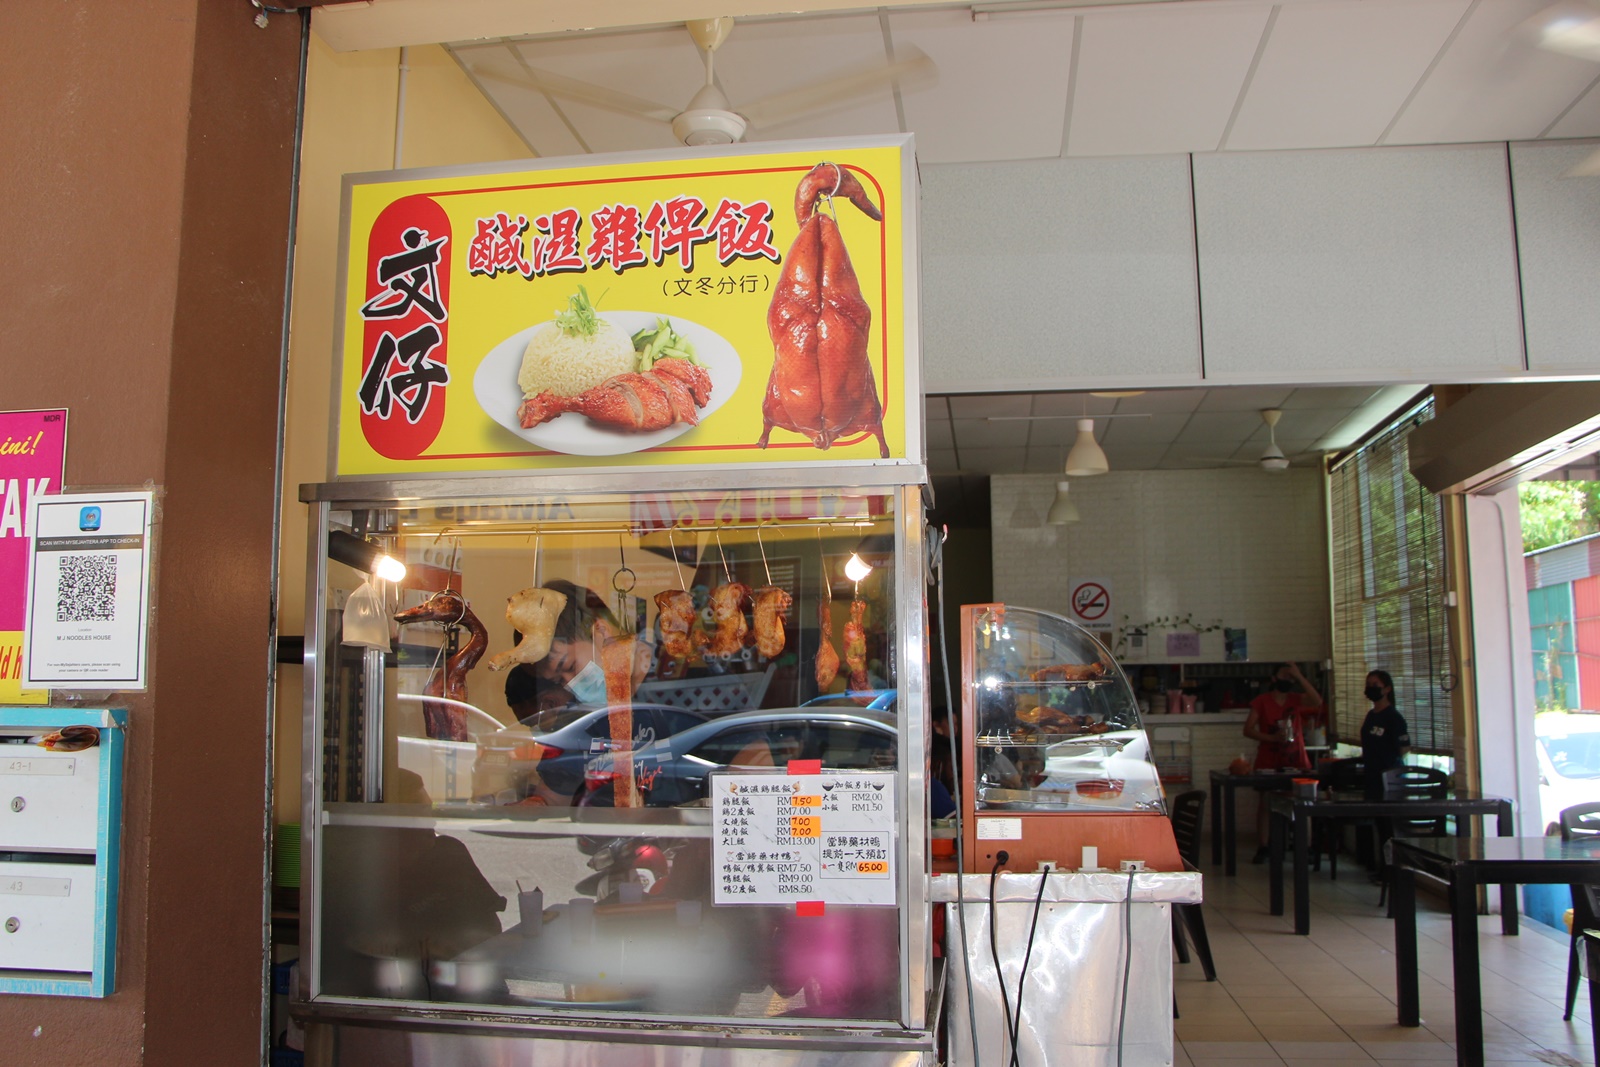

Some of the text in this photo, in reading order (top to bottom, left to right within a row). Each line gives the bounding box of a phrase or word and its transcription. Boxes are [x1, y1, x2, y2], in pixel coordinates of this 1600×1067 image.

[358, 227, 450, 424] 文仔
[43, 414, 61, 423] MDR
[9, 761, 32, 771] 43-1
[822, 793, 883, 801] 大飯 RM2.00
[776, 807, 811, 815] RM7.00
[821, 803, 883, 812] 小飯 RM1.50
[776, 837, 815, 846] RM13.00
[777, 863, 811, 872] RM7.50
[778, 874, 813, 883] RM9.00
[778, 884, 813, 893] RM8.50
